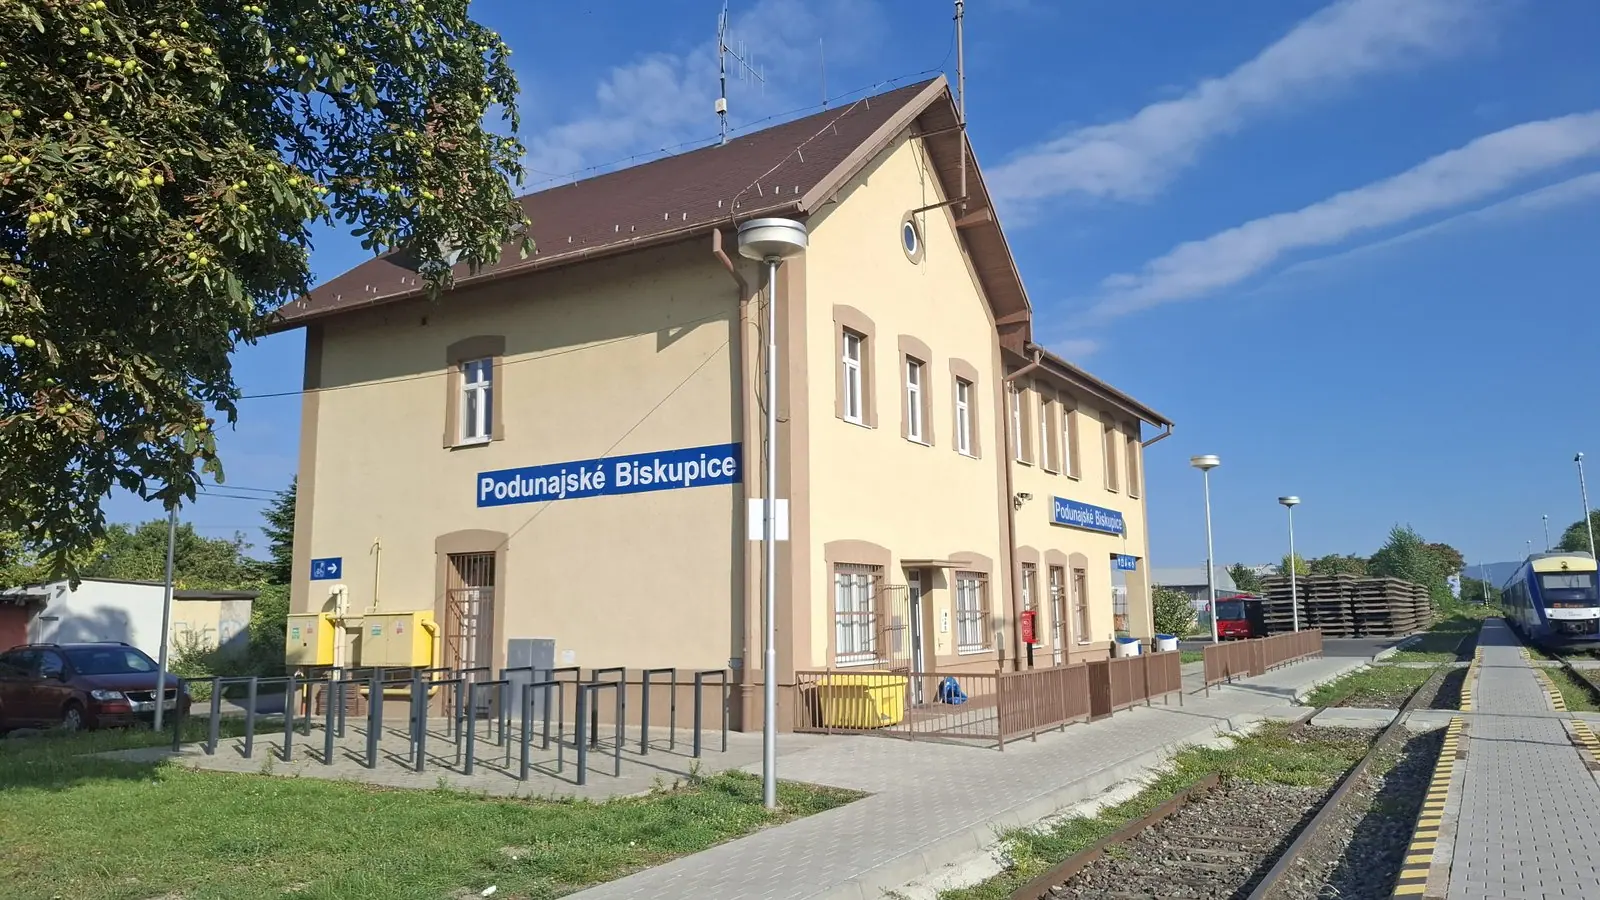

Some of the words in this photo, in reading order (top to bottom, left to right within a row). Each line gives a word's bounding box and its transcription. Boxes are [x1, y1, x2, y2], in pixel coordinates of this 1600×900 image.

[481, 464, 606, 501] Podunajské
[616, 454, 736, 486] Biskupice
[1055, 502, 1094, 526] Podunajské
[1095, 510, 1122, 532] Biskupice
